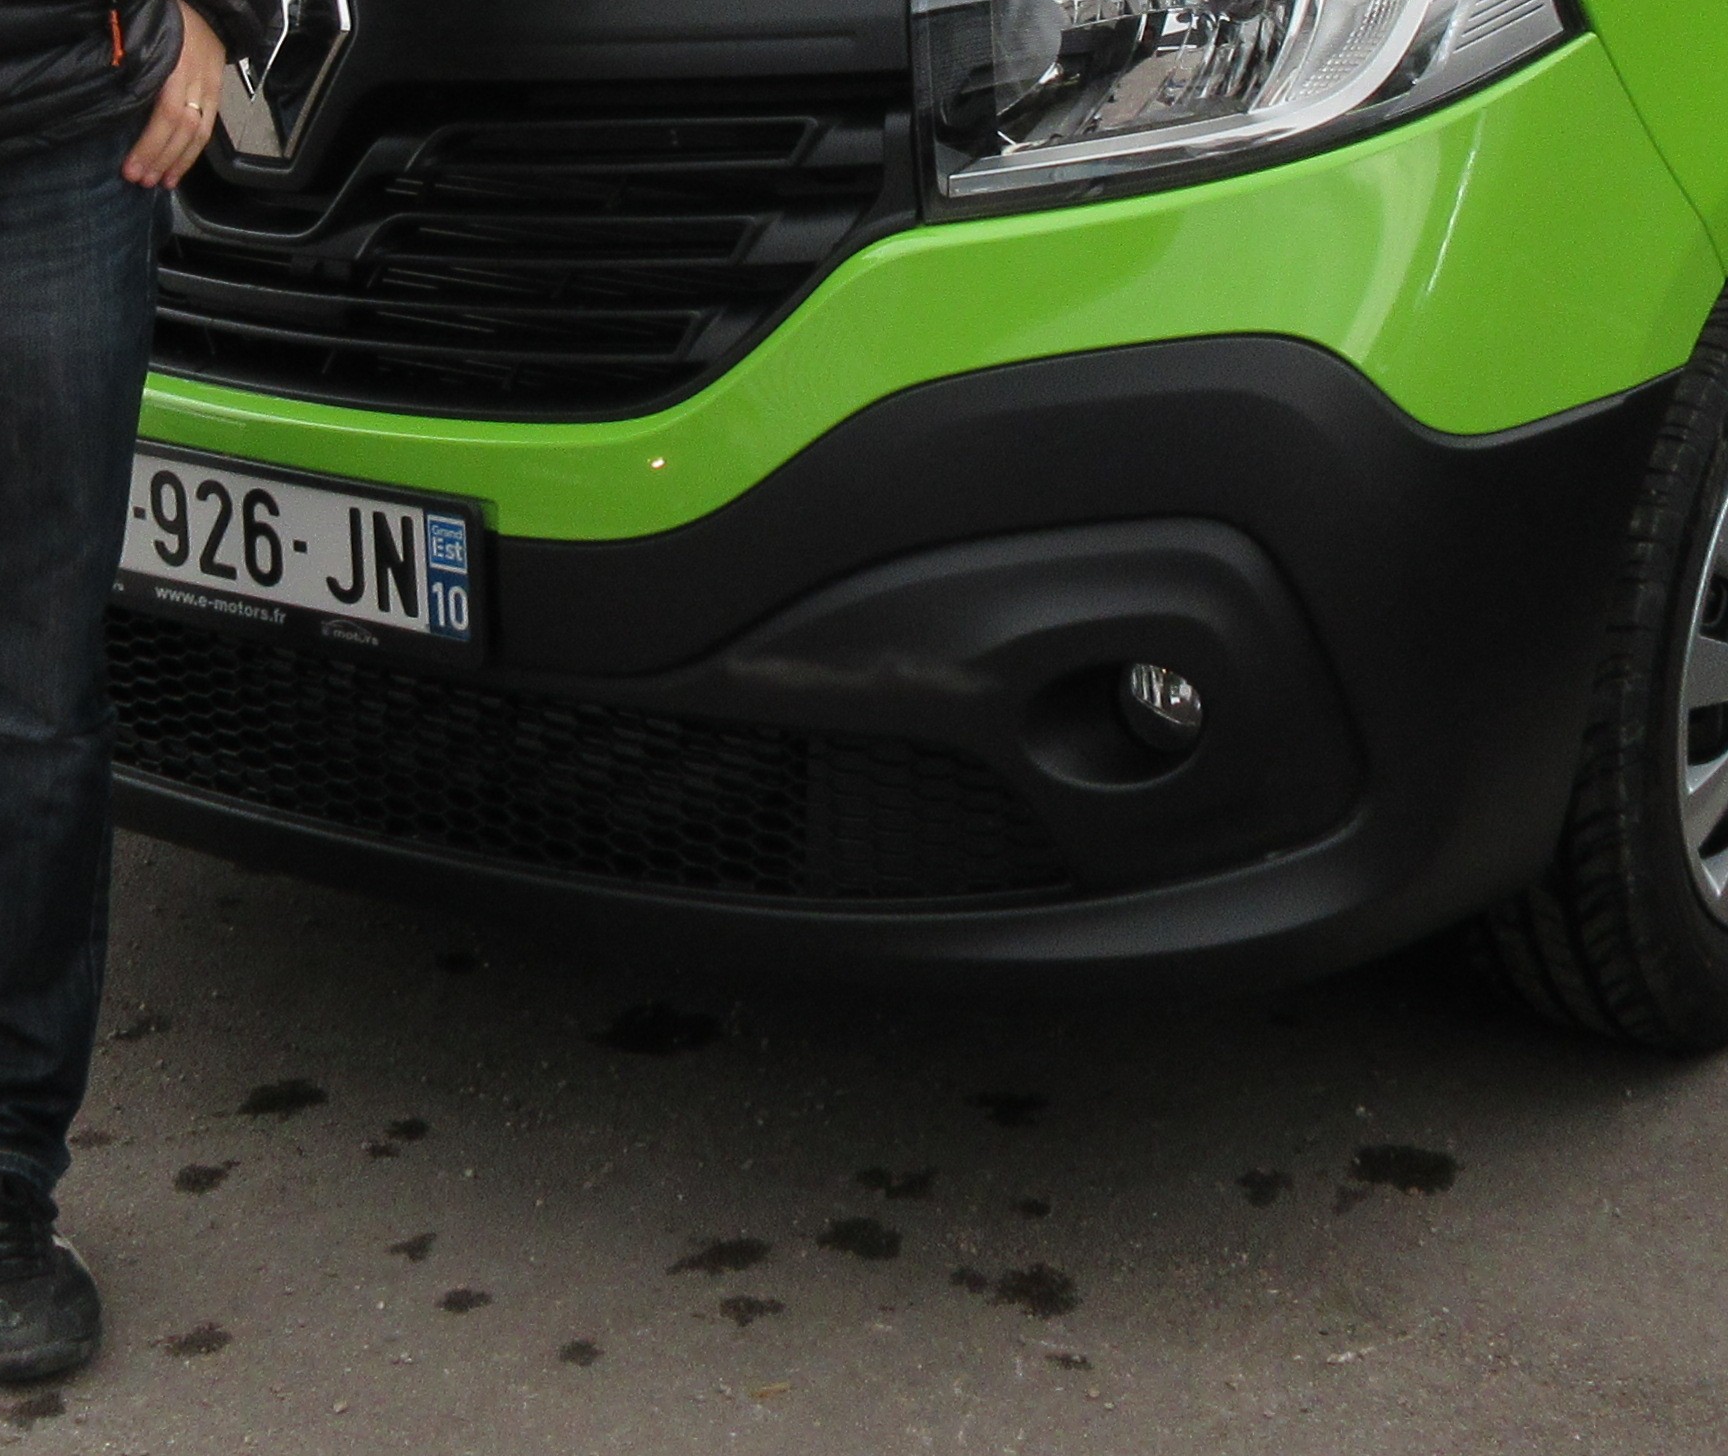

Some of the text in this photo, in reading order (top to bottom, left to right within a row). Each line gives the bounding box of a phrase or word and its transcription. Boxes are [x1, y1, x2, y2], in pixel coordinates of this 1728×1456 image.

[432, 536, 464, 562] Est
[154, 585, 288, 625] www.e-motors.fr
[432, 581, 470, 632] 10
